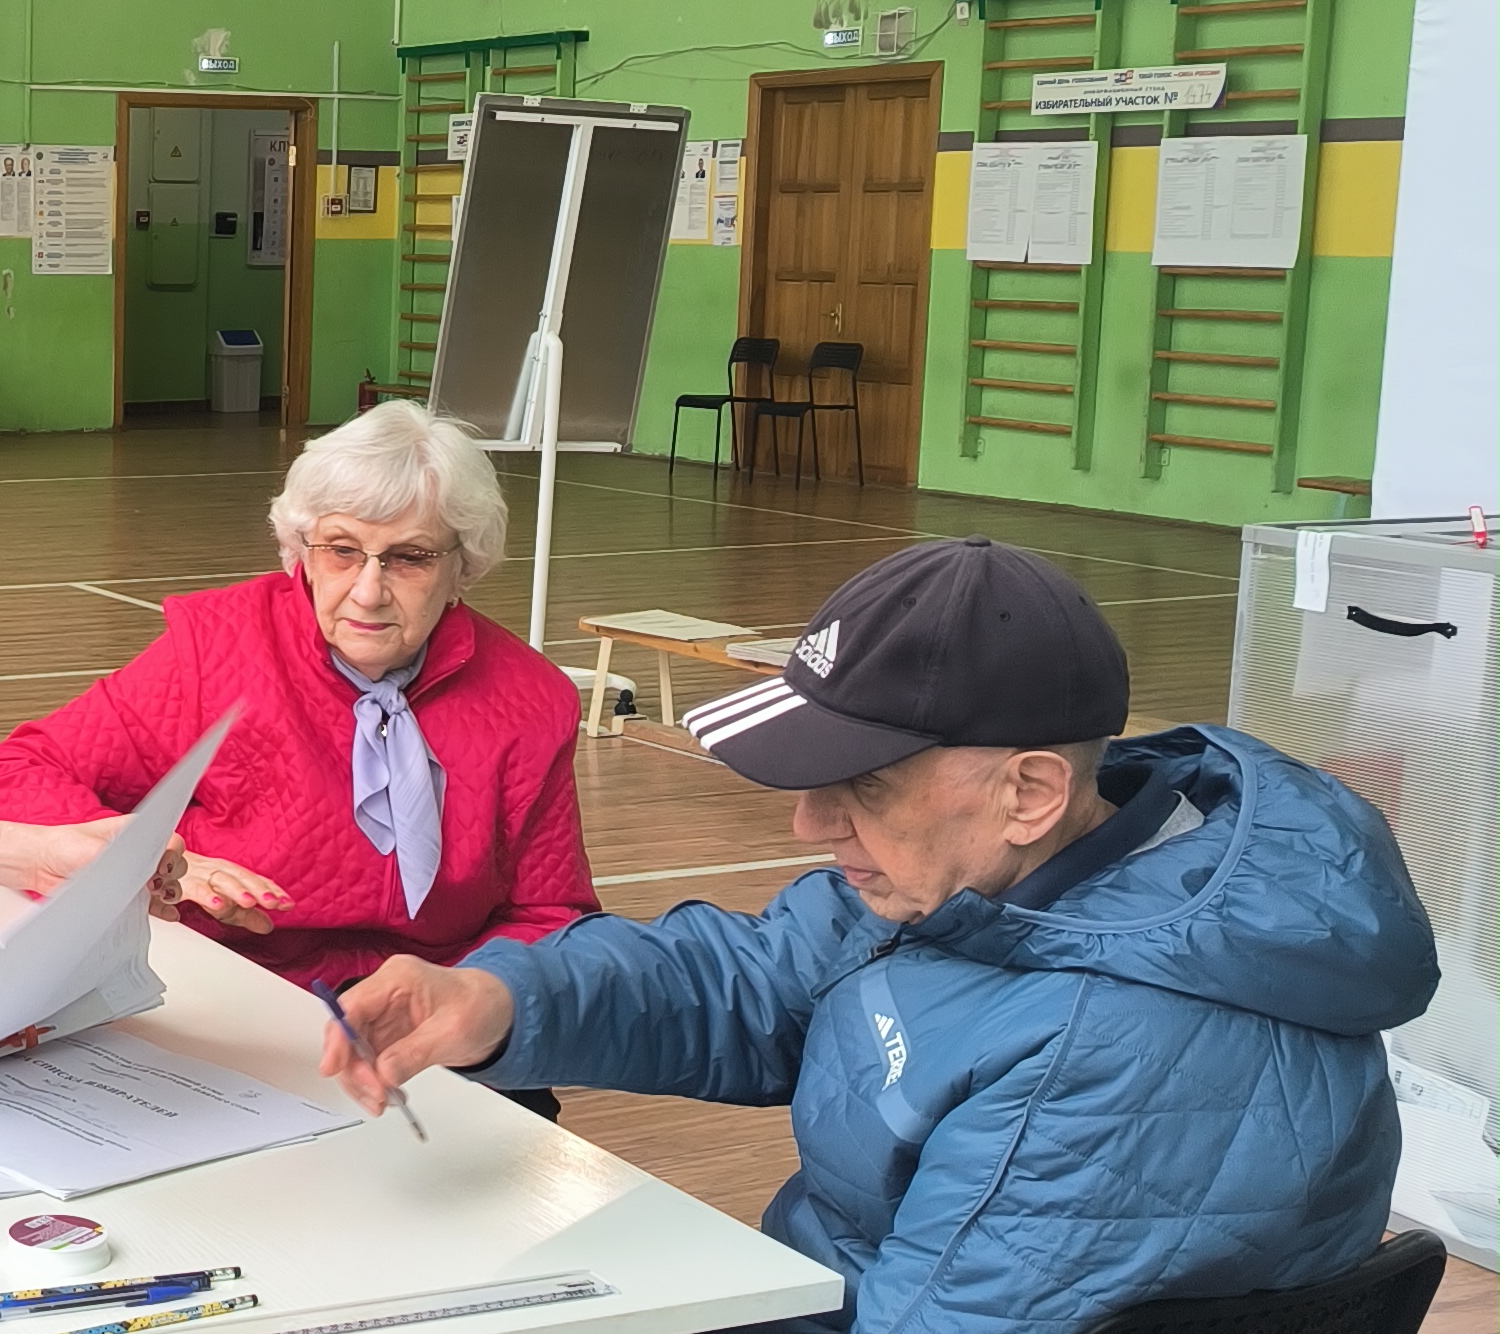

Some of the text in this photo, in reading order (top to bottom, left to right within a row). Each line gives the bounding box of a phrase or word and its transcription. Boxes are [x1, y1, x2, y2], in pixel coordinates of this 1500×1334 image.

[1035, 92, 1178, 109] ИЗБИРАТЕЛЬНЫЙ УЧАСТОК №
